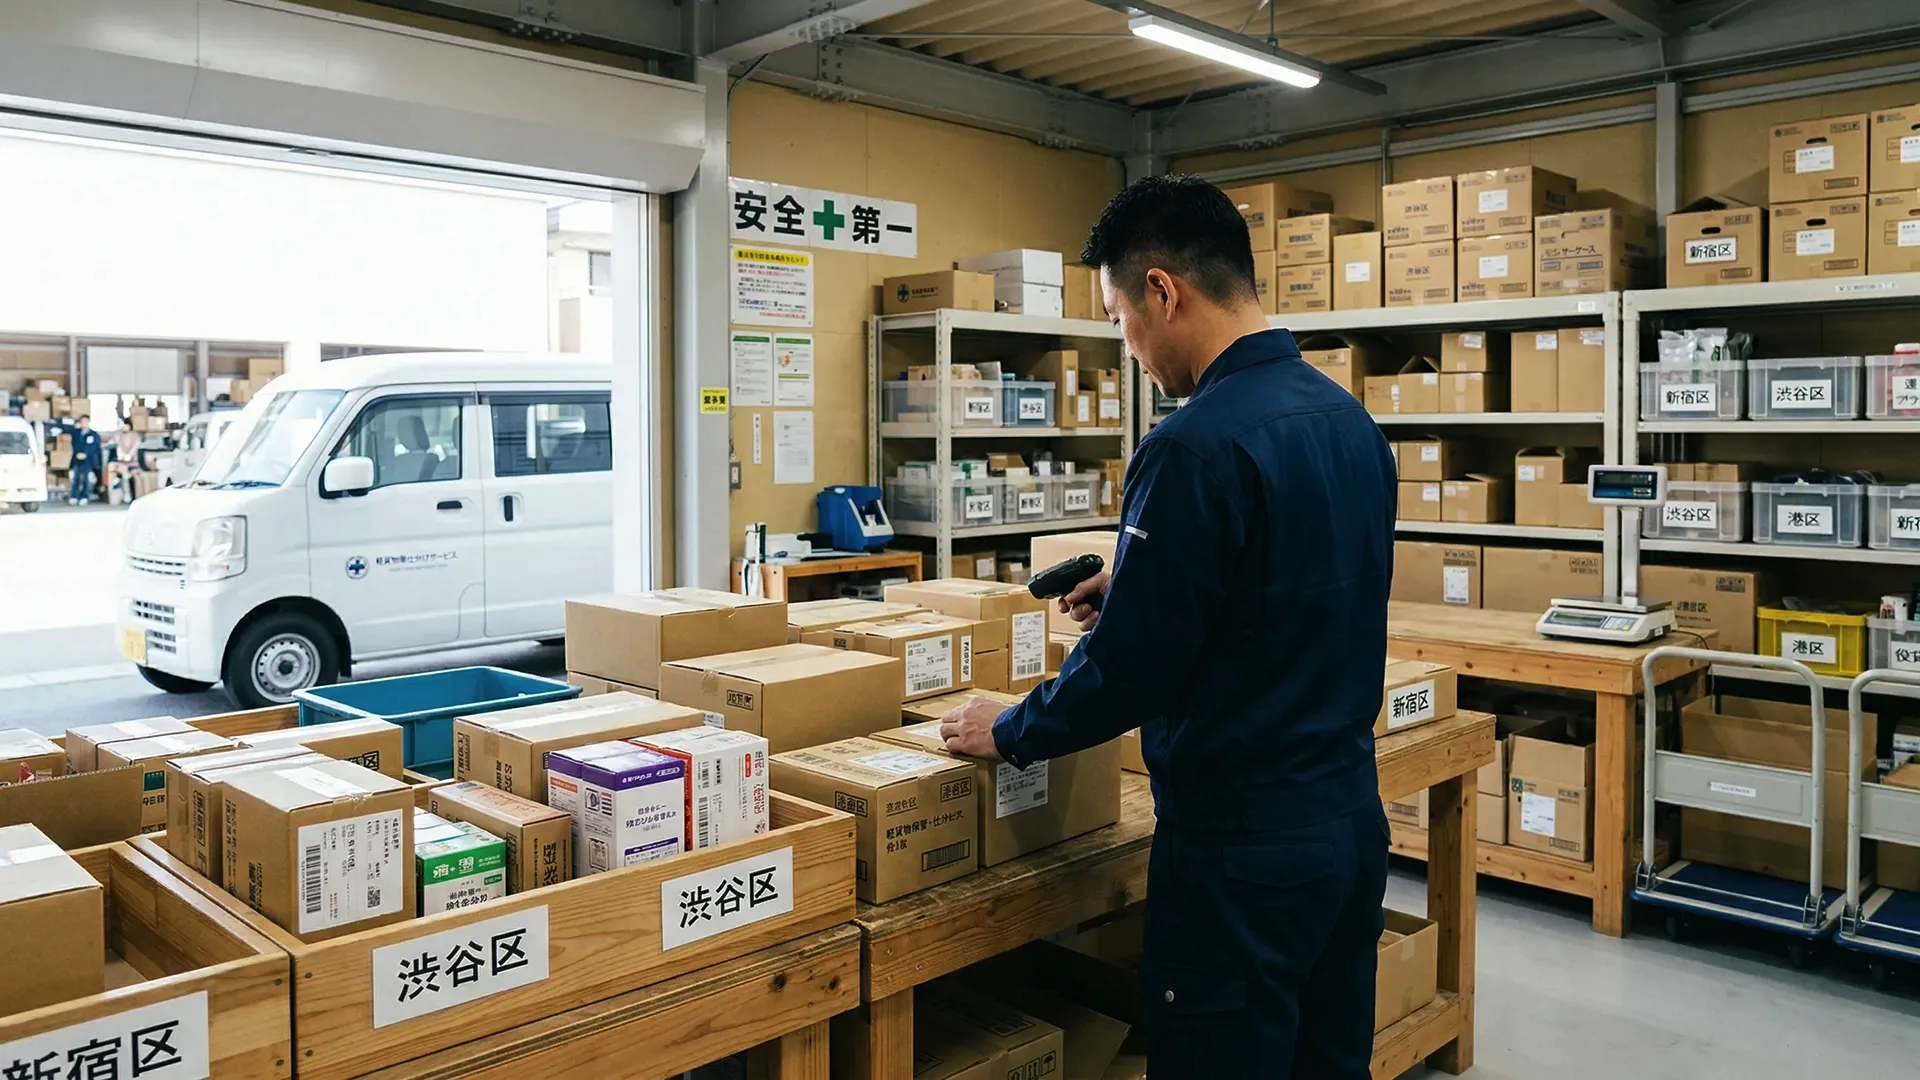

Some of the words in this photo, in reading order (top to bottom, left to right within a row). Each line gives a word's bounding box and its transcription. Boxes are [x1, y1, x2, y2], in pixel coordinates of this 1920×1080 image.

[734, 190, 805, 237] 安全
[851, 204, 913, 244] 第一
[1689, 242, 1731, 259] 新宿区
[1666, 389, 1710, 405] 新宿区
[1776, 385, 1826, 402] 渋谷区
[1666, 506, 1712, 522] 渋谷区
[1787, 511, 1821, 527] 港区
[1792, 639, 1825, 656] 港区
[1393, 689, 1429, 719] 新宿区
[679, 865, 779, 928] 渋谷区
[397, 928, 529, 1003] 渋谷区
